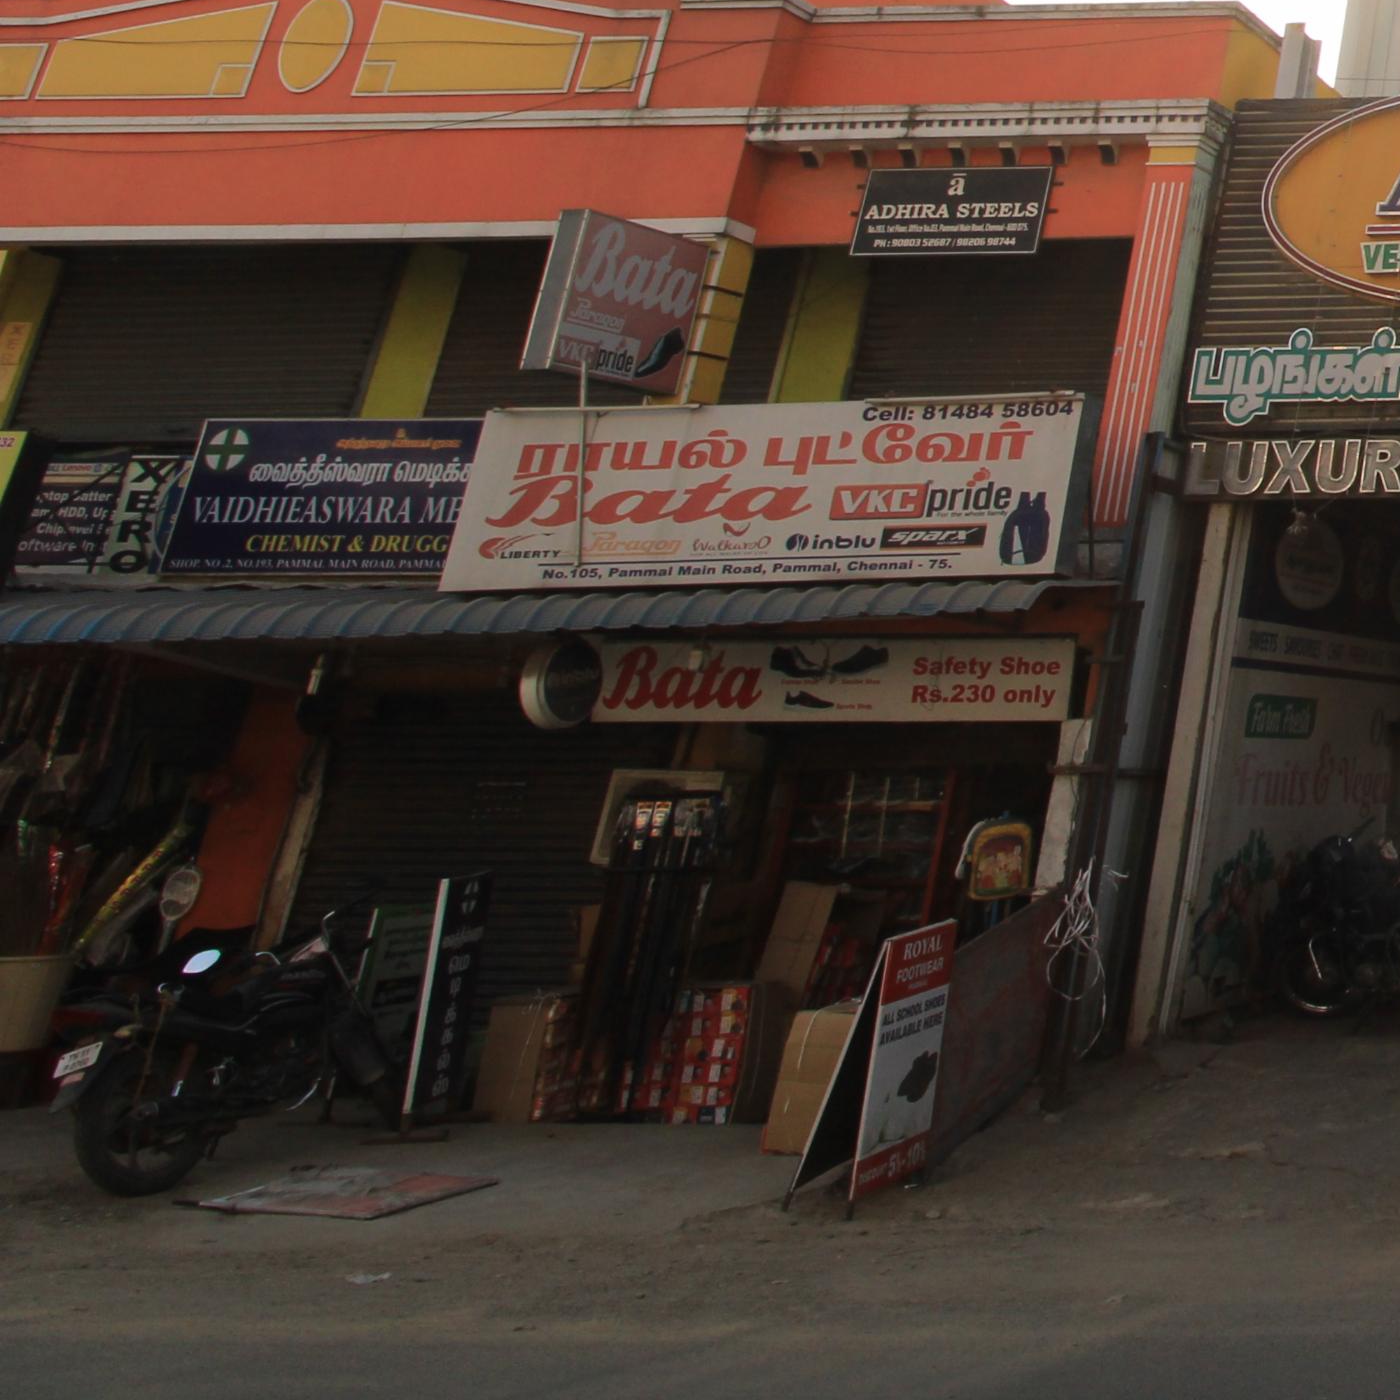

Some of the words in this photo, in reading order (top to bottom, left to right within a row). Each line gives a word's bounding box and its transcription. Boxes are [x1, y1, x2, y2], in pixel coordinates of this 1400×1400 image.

[864, 203, 949, 219] ADHIRA
[957, 202, 1039, 218] STEELS
[574, 222, 698, 319] Bata
[596, 345, 634, 374] pride
[862, 406, 915, 421] Cell:
[922, 404, 994, 420] 81484
[1002, 401, 1074, 418] 58604
[513, 429, 748, 481] ராயல்
[763, 421, 1034, 476] புட்வேர்
[193, 496, 412, 524] VAIDHIEASWARA
[485, 474, 812, 528] Bata
[839, 487, 922, 514] VKC
[925, 479, 1013, 519] pride
[245, 535, 343, 552] CHEMIST
[348, 535, 364, 552] &
[591, 531, 682, 553] Paragon
[812, 532, 876, 550] inblu
[500, 550, 560, 560] LIBERTY
[542, 567, 602, 580] No.105,
[608, 566, 672, 578] Pammal
[677, 565, 722, 576] Main
[725, 564, 766, 576] Road,
[772, 562, 840, 575] Pammal,
[847, 560, 912, 572] Chennai
[929, 559, 952, 569] 75.
[602, 645, 763, 710] Bata
[912, 656, 992, 680] Safety
[999, 656, 1061, 676] Shoe
[911, 684, 995, 704] Rs.230
[1003, 686, 1056, 707] only
[903, 934, 944, 961] ROYAL
[895, 957, 945, 984] FOOTWEAR
[879, 1017, 922, 1046] AVAILABLE
